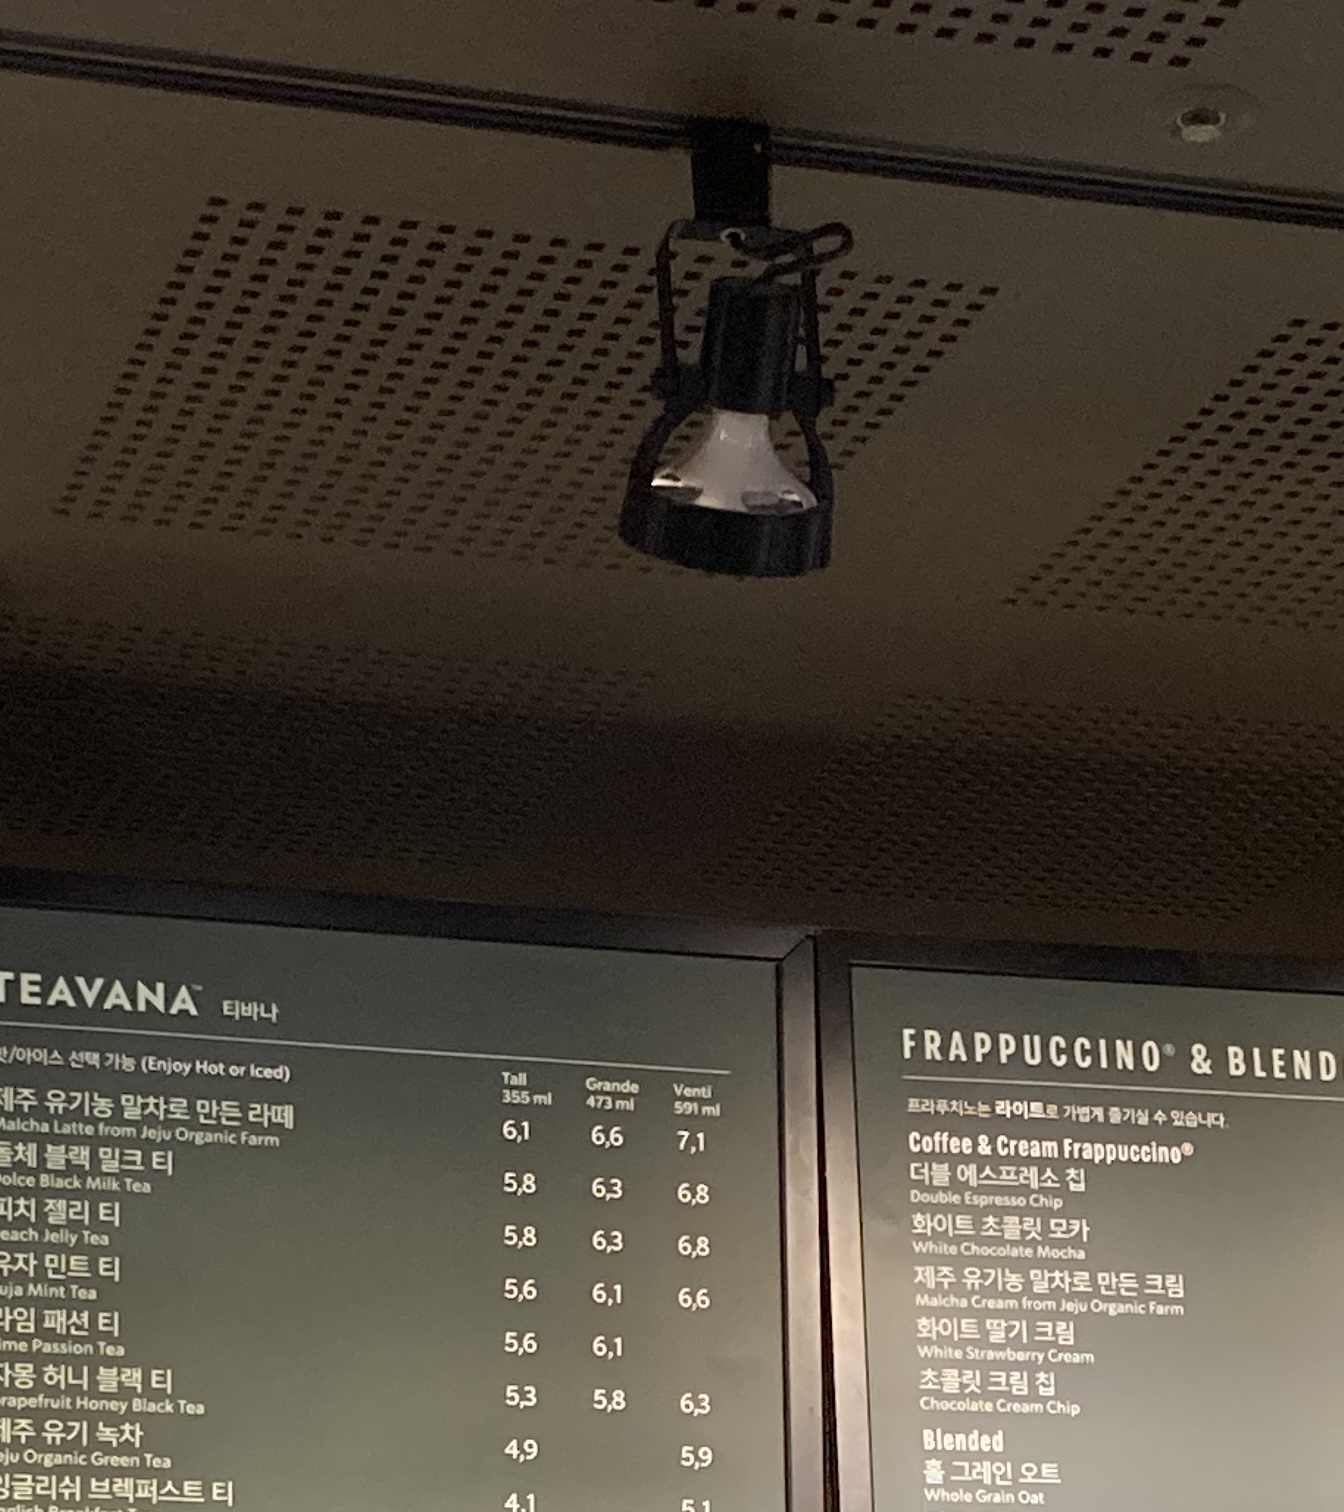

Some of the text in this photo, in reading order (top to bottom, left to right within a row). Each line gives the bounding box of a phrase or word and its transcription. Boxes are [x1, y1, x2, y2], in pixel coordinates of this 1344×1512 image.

[222, 999, 279, 1023] 티바나
[67, 1050, 100, 1069] 선택
[104, 1052, 136, 1072] 가능
[140, 1055, 192, 1077] (Enjoy
[194, 1059, 226, 1076] Hot
[227, 1064, 246, 1077] or
[248, 1062, 290, 1083] Iced)
[1190, 1042, 1213, 1075] &
[43, 1088, 115, 1118] 유기농
[120, 1093, 191, 1121] 말차로
[195, 1098, 243, 1126] 만든
[247, 1102, 294, 1130] 라떼
[52, 1118, 95, 1136] Latte
[97, 1121, 137, 1138] from
[139, 1123, 172, 1143] Jeju
[174, 1126, 237, 1146] Organic
[239, 1129, 280, 1147] Farm
[908, 1130, 973, 1155] Coffee
[976, 1133, 992, 1155] &
[995, 1134, 1058, 1158] Cream
[909, 1160, 1085, 1192] 더블 에스프레소 칩
[42, 1197, 89, 1226] 젤리
[98, 1201, 120, 1227] 티
[42, 1227, 78, 1247] Jelly
[80, 1229, 109, 1246] Tea
[921, 1426, 1004, 1452] Blended
